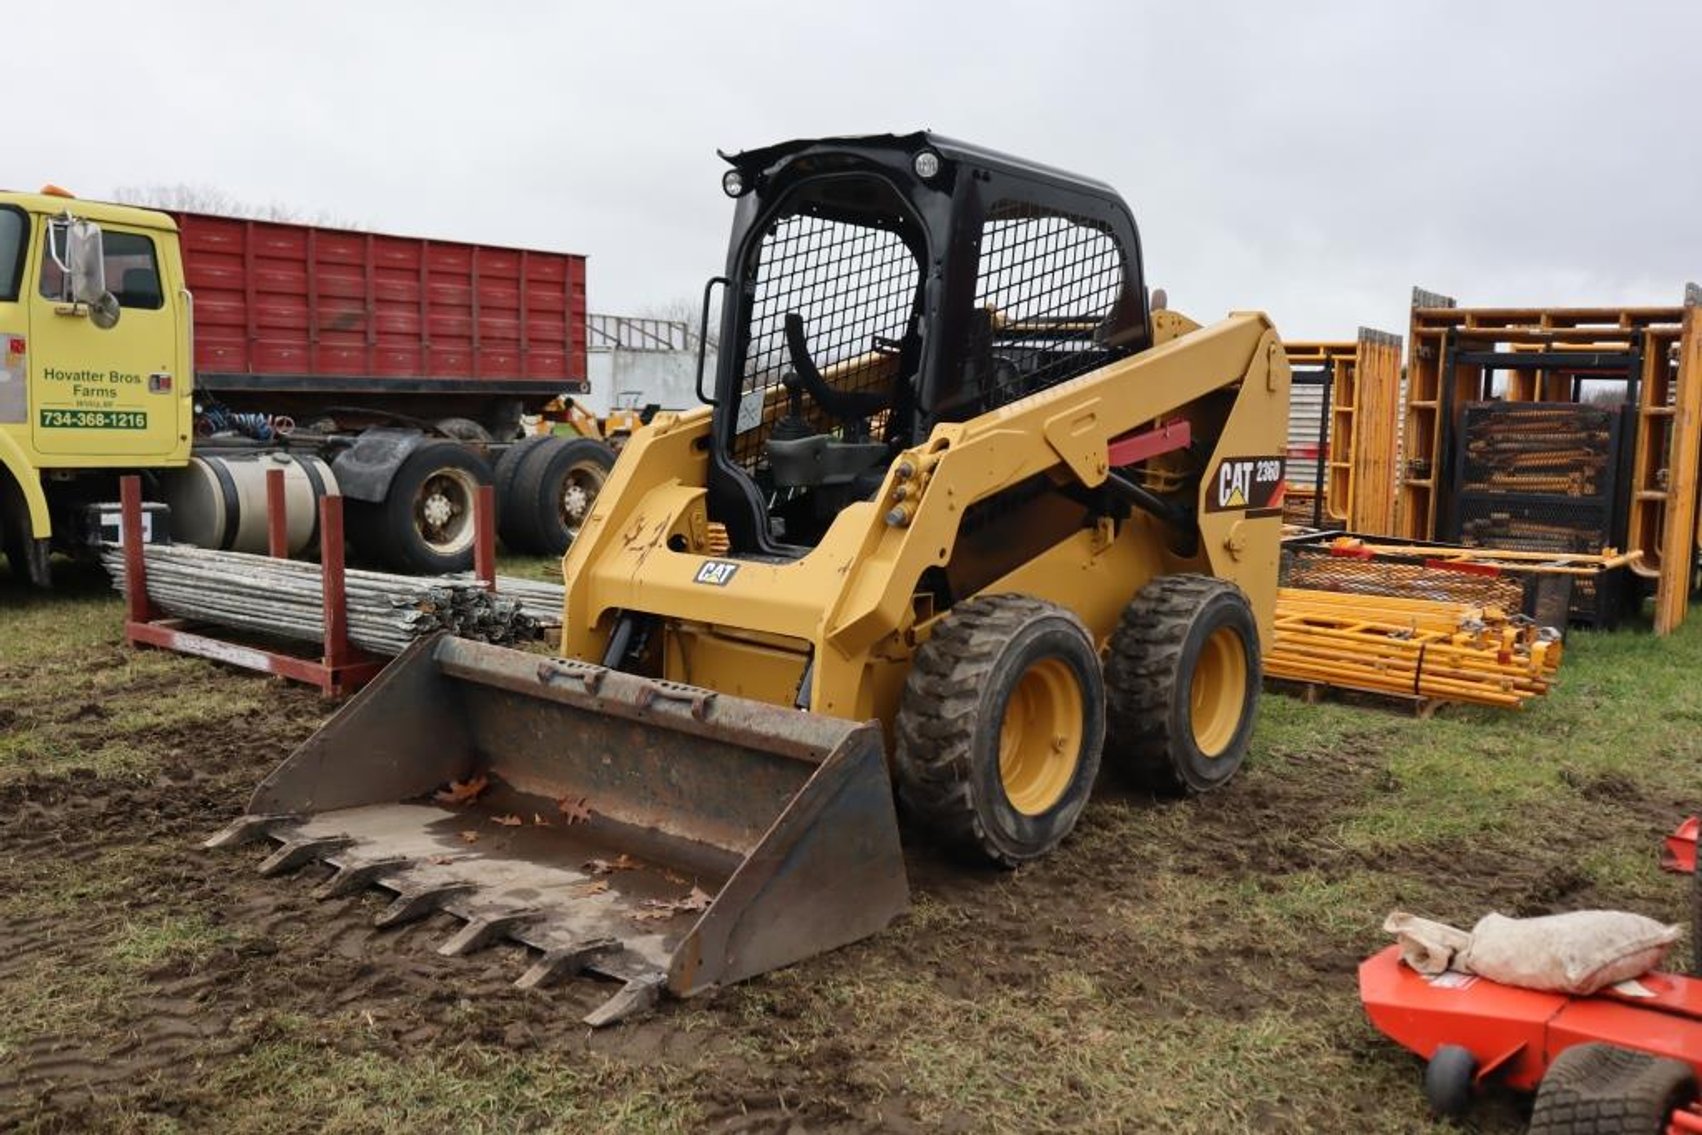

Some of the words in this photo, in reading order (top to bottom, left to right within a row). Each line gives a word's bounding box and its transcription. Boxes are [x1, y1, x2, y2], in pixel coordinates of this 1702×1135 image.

[44, 368, 106, 383] Hovatter
[73, 384, 118, 398] Farms
[42, 411, 145, 427] 734-368-1216
[1219, 461, 1254, 507] CAT
[697, 561, 737, 584] CAT
